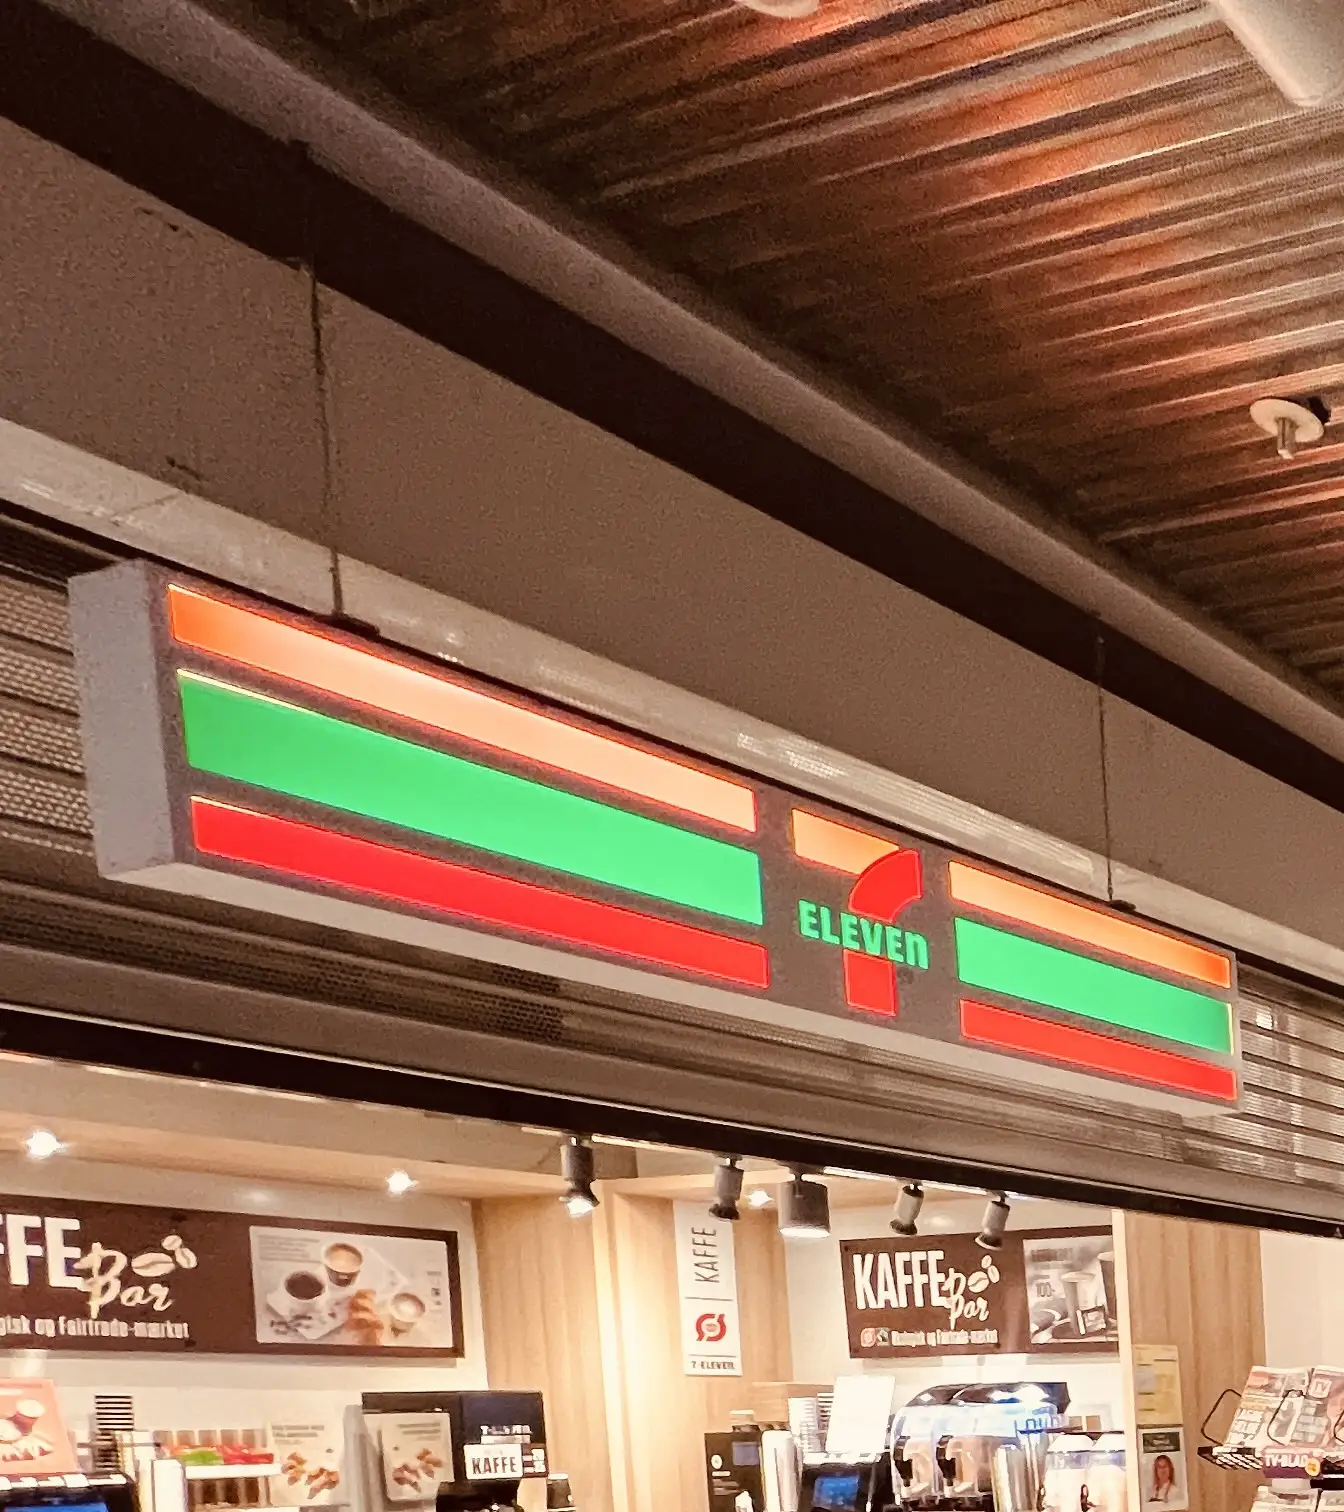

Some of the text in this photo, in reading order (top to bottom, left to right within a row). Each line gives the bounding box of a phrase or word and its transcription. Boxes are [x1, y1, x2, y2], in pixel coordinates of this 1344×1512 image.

[0, 1213, 82, 1289] FE
[72, 1241, 176, 1319] Bar
[691, 1226, 720, 1284] KAFFE
[852, 1250, 946, 1310] KAFFE
[35, 1317, 56, 1337] og
[940, 1267, 990, 1330] Bar
[471, 1456, 517, 1475] KAFFE
